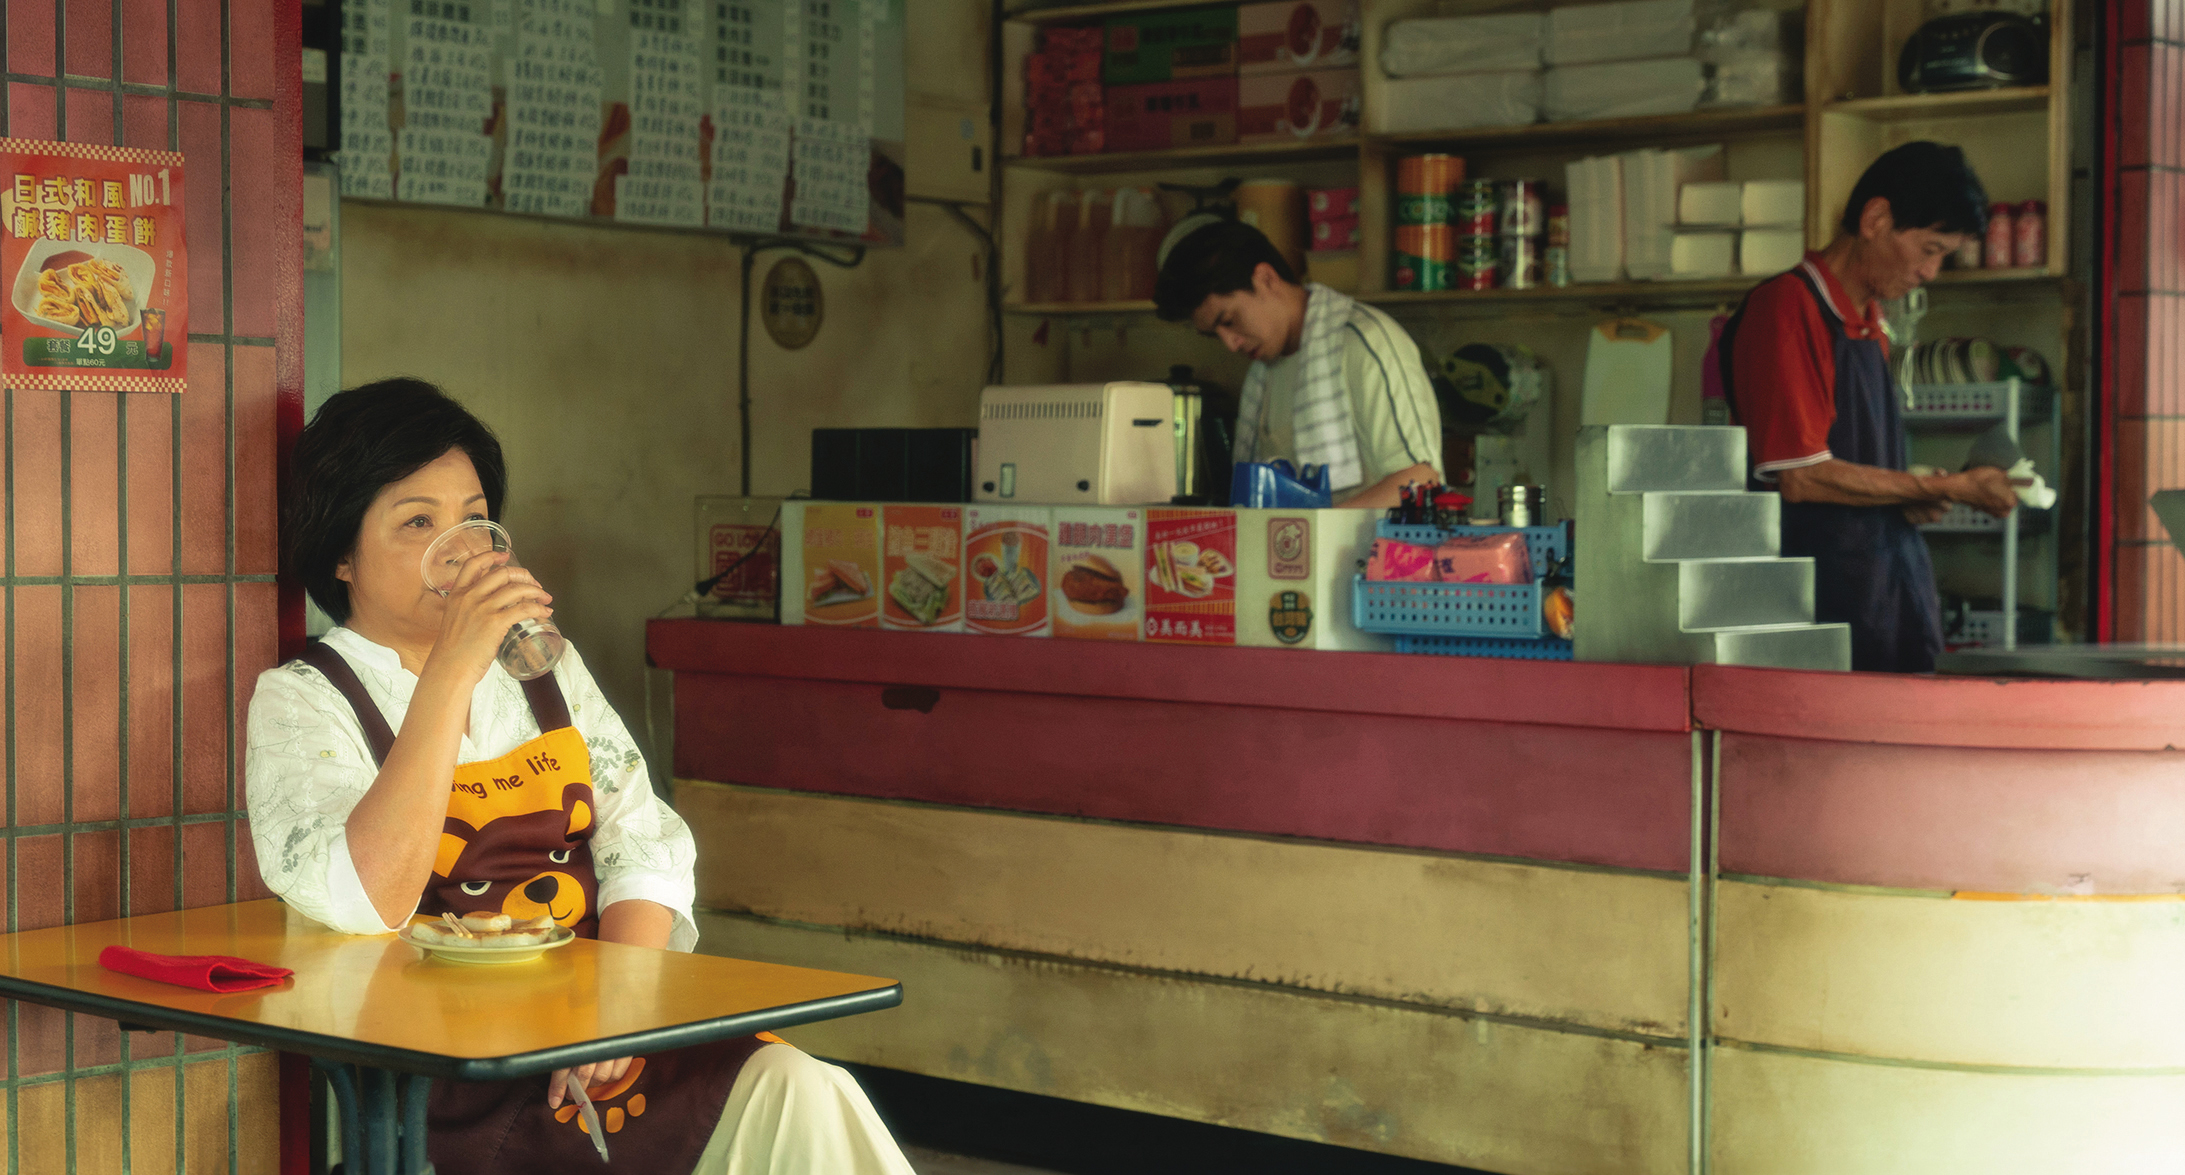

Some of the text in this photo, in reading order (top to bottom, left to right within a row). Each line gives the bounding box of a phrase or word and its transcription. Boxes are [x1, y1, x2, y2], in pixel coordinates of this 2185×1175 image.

[13, 173, 126, 209] 日式和風
[129, 168, 170, 208] NO.1
[13, 207, 157, 247] 鹹豬肉蛋餅
[46, 326, 138, 355] 套餐 49 元
[75, 358, 106, 366] 單點60元
[492, 775, 524, 791] me
[526, 751, 561, 776] life
